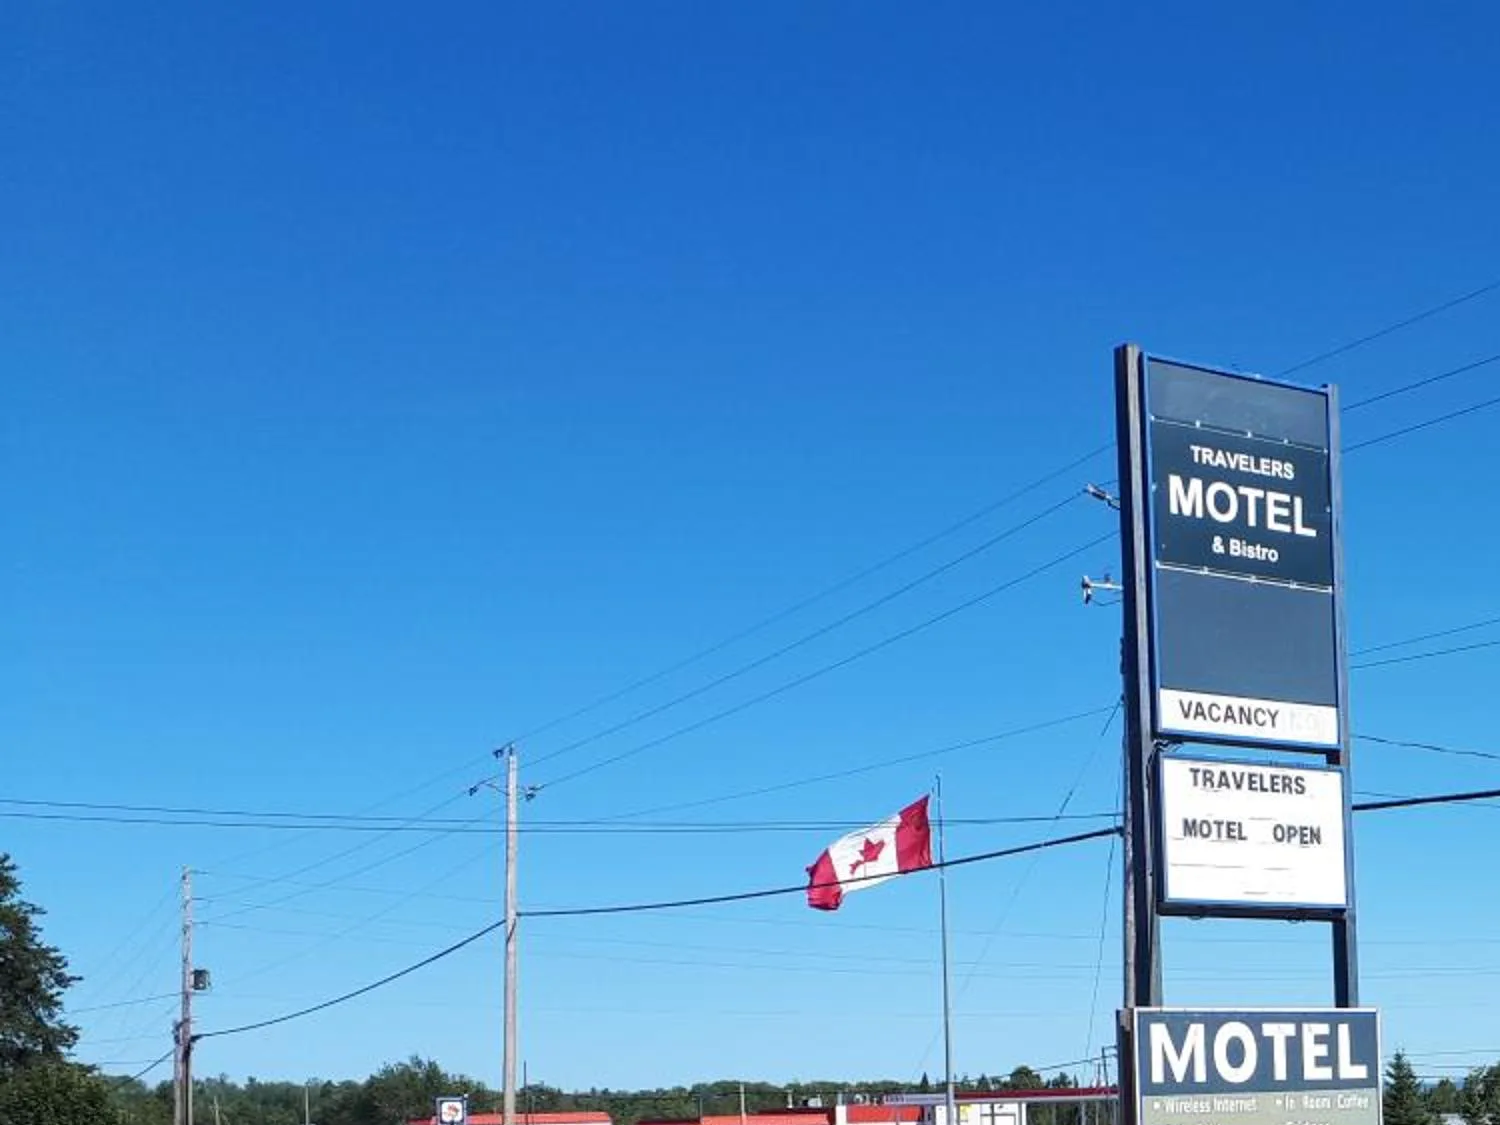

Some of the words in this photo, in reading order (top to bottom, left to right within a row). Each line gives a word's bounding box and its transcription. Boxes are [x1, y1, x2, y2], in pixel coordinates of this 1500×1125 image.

[1190, 445, 1295, 480] TRAVELERS
[1168, 474, 1316, 537] MOTEL
[1211, 536, 1225, 554] &
[1229, 538, 1279, 562] Bistro
[1178, 698, 1280, 728] VACANCY
[1189, 768, 1307, 795] TRAVELERS
[1182, 818, 1248, 841] MOTEL
[1272, 823, 1322, 845] OPEN
[1150, 1021, 1369, 1083] MOTEL
[1164, 1099, 1211, 1114] Wireless
[1213, 1097, 1258, 1113] Internet
